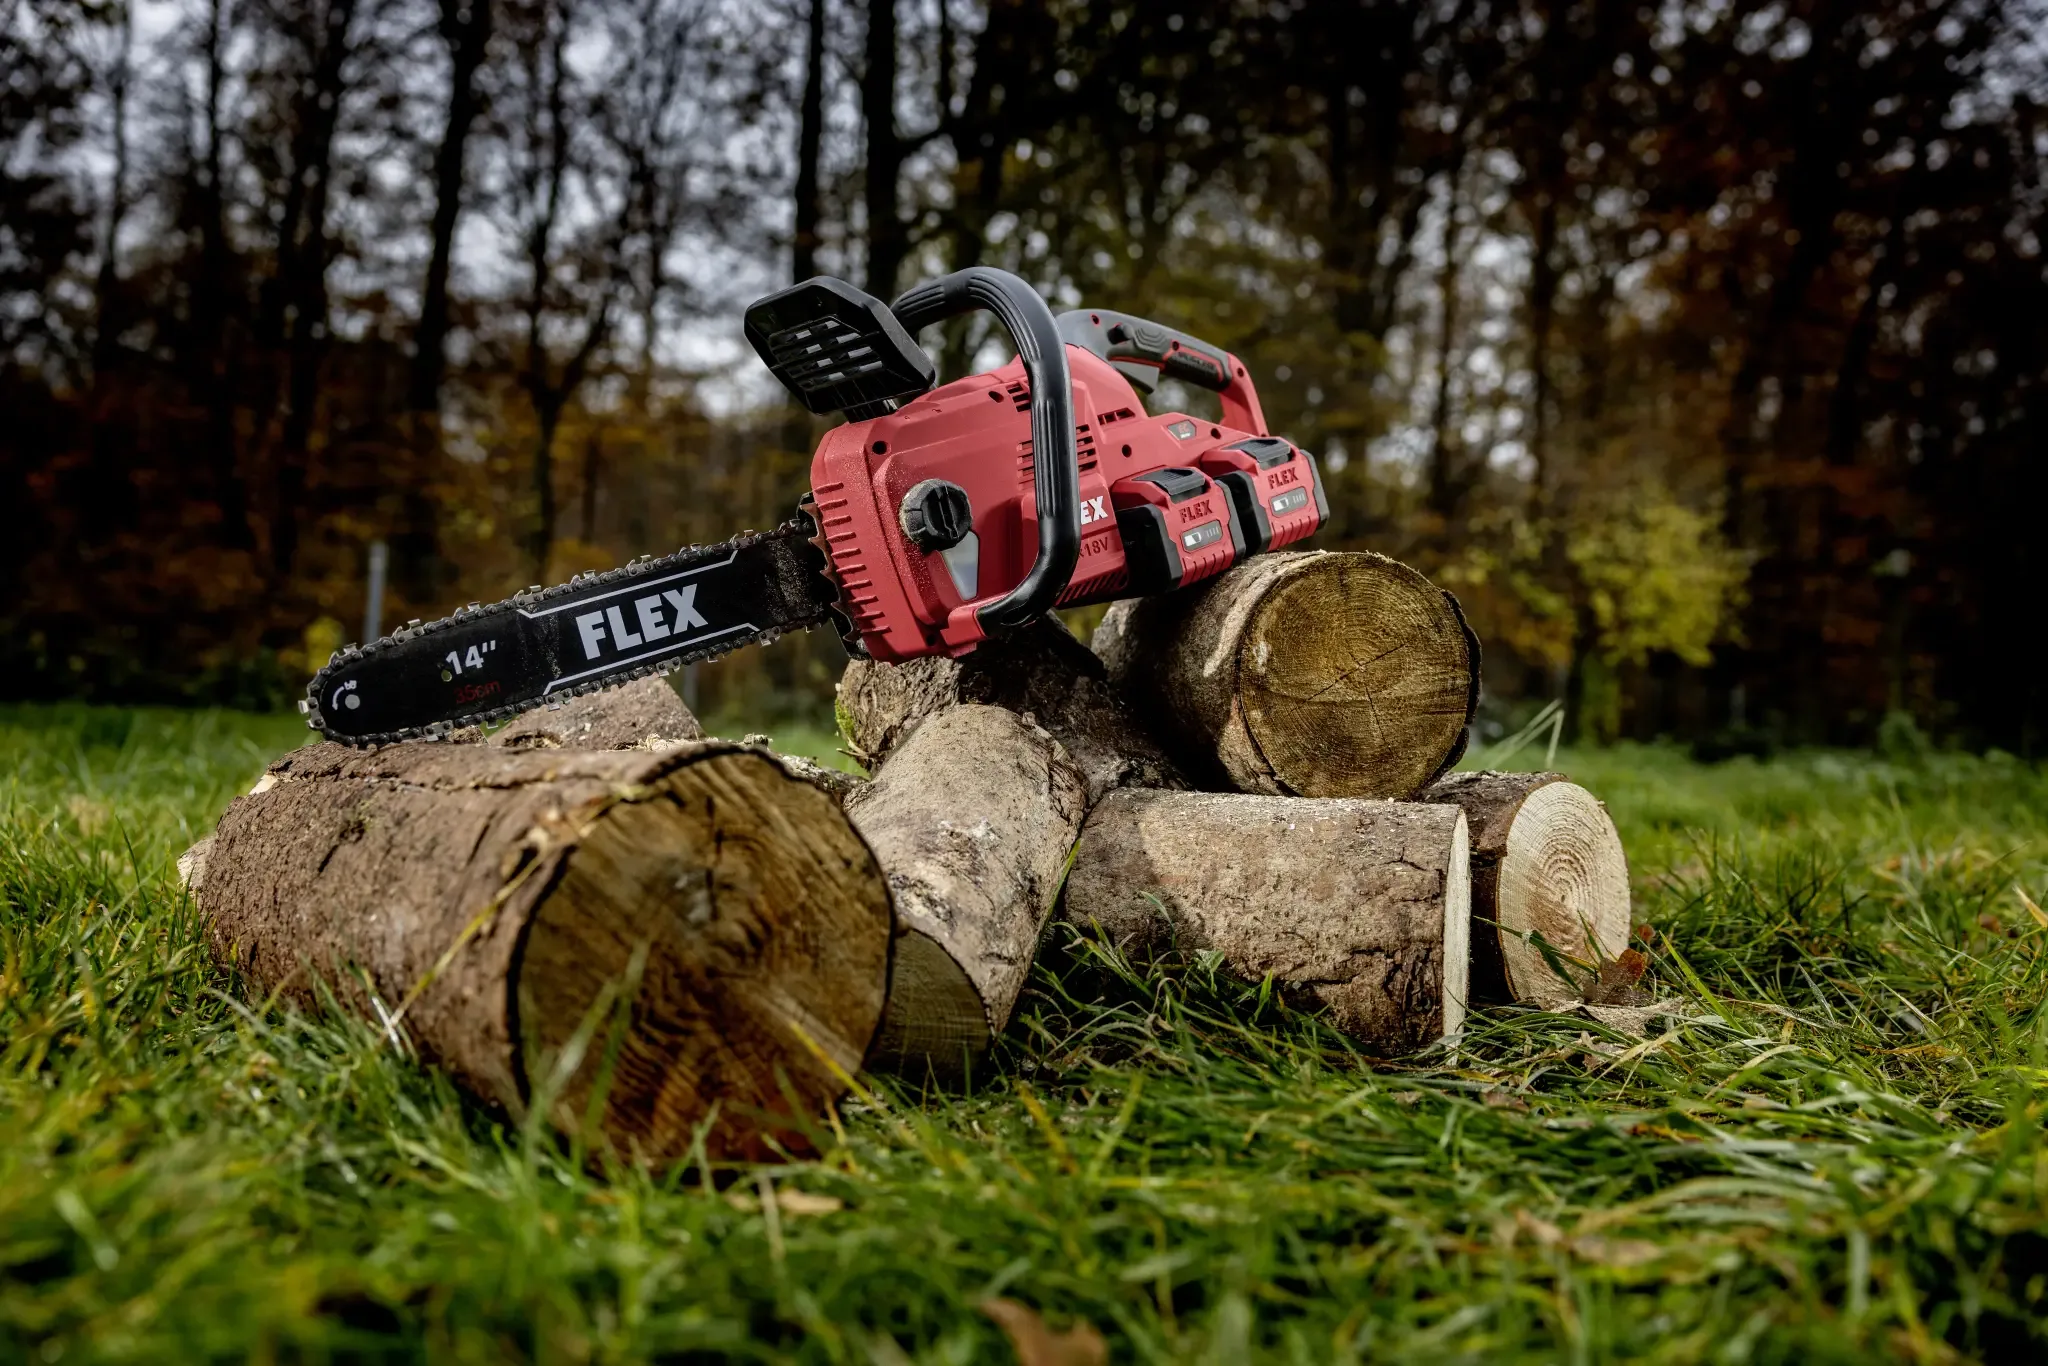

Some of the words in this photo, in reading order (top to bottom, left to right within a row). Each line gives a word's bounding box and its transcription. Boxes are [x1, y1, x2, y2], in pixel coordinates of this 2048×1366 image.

[1267, 467, 1299, 490] FLEX
[1080, 496, 1108, 525] EX
[1178, 499, 1214, 524] FLEX
[575, 583, 709, 660] FLEX
